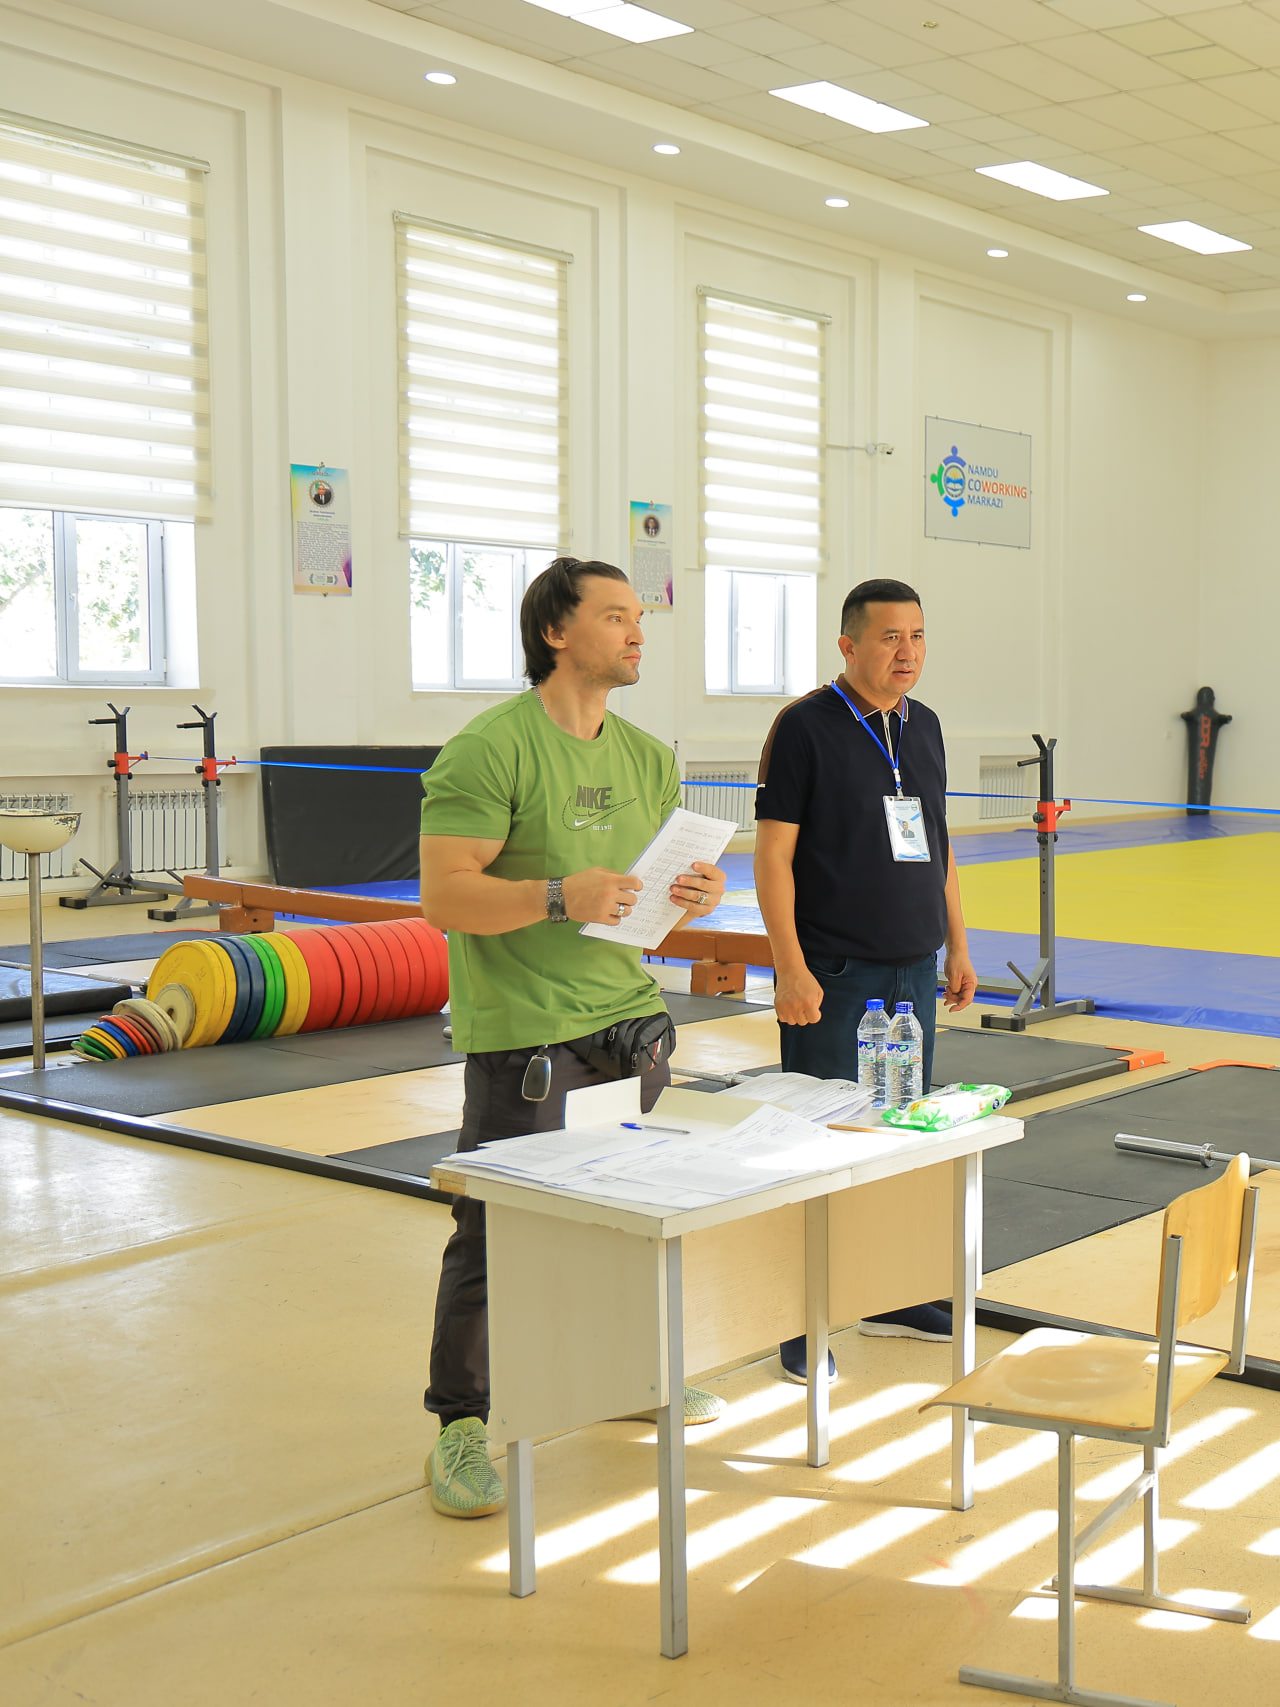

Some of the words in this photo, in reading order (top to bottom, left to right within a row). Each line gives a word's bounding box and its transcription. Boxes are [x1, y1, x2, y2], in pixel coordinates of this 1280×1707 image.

[968, 464, 999, 479] NAMDU
[967, 478, 1028, 500] COWORKING
[967, 494, 1004, 509] MARKAZI
[576, 785, 612, 810] NIKE
